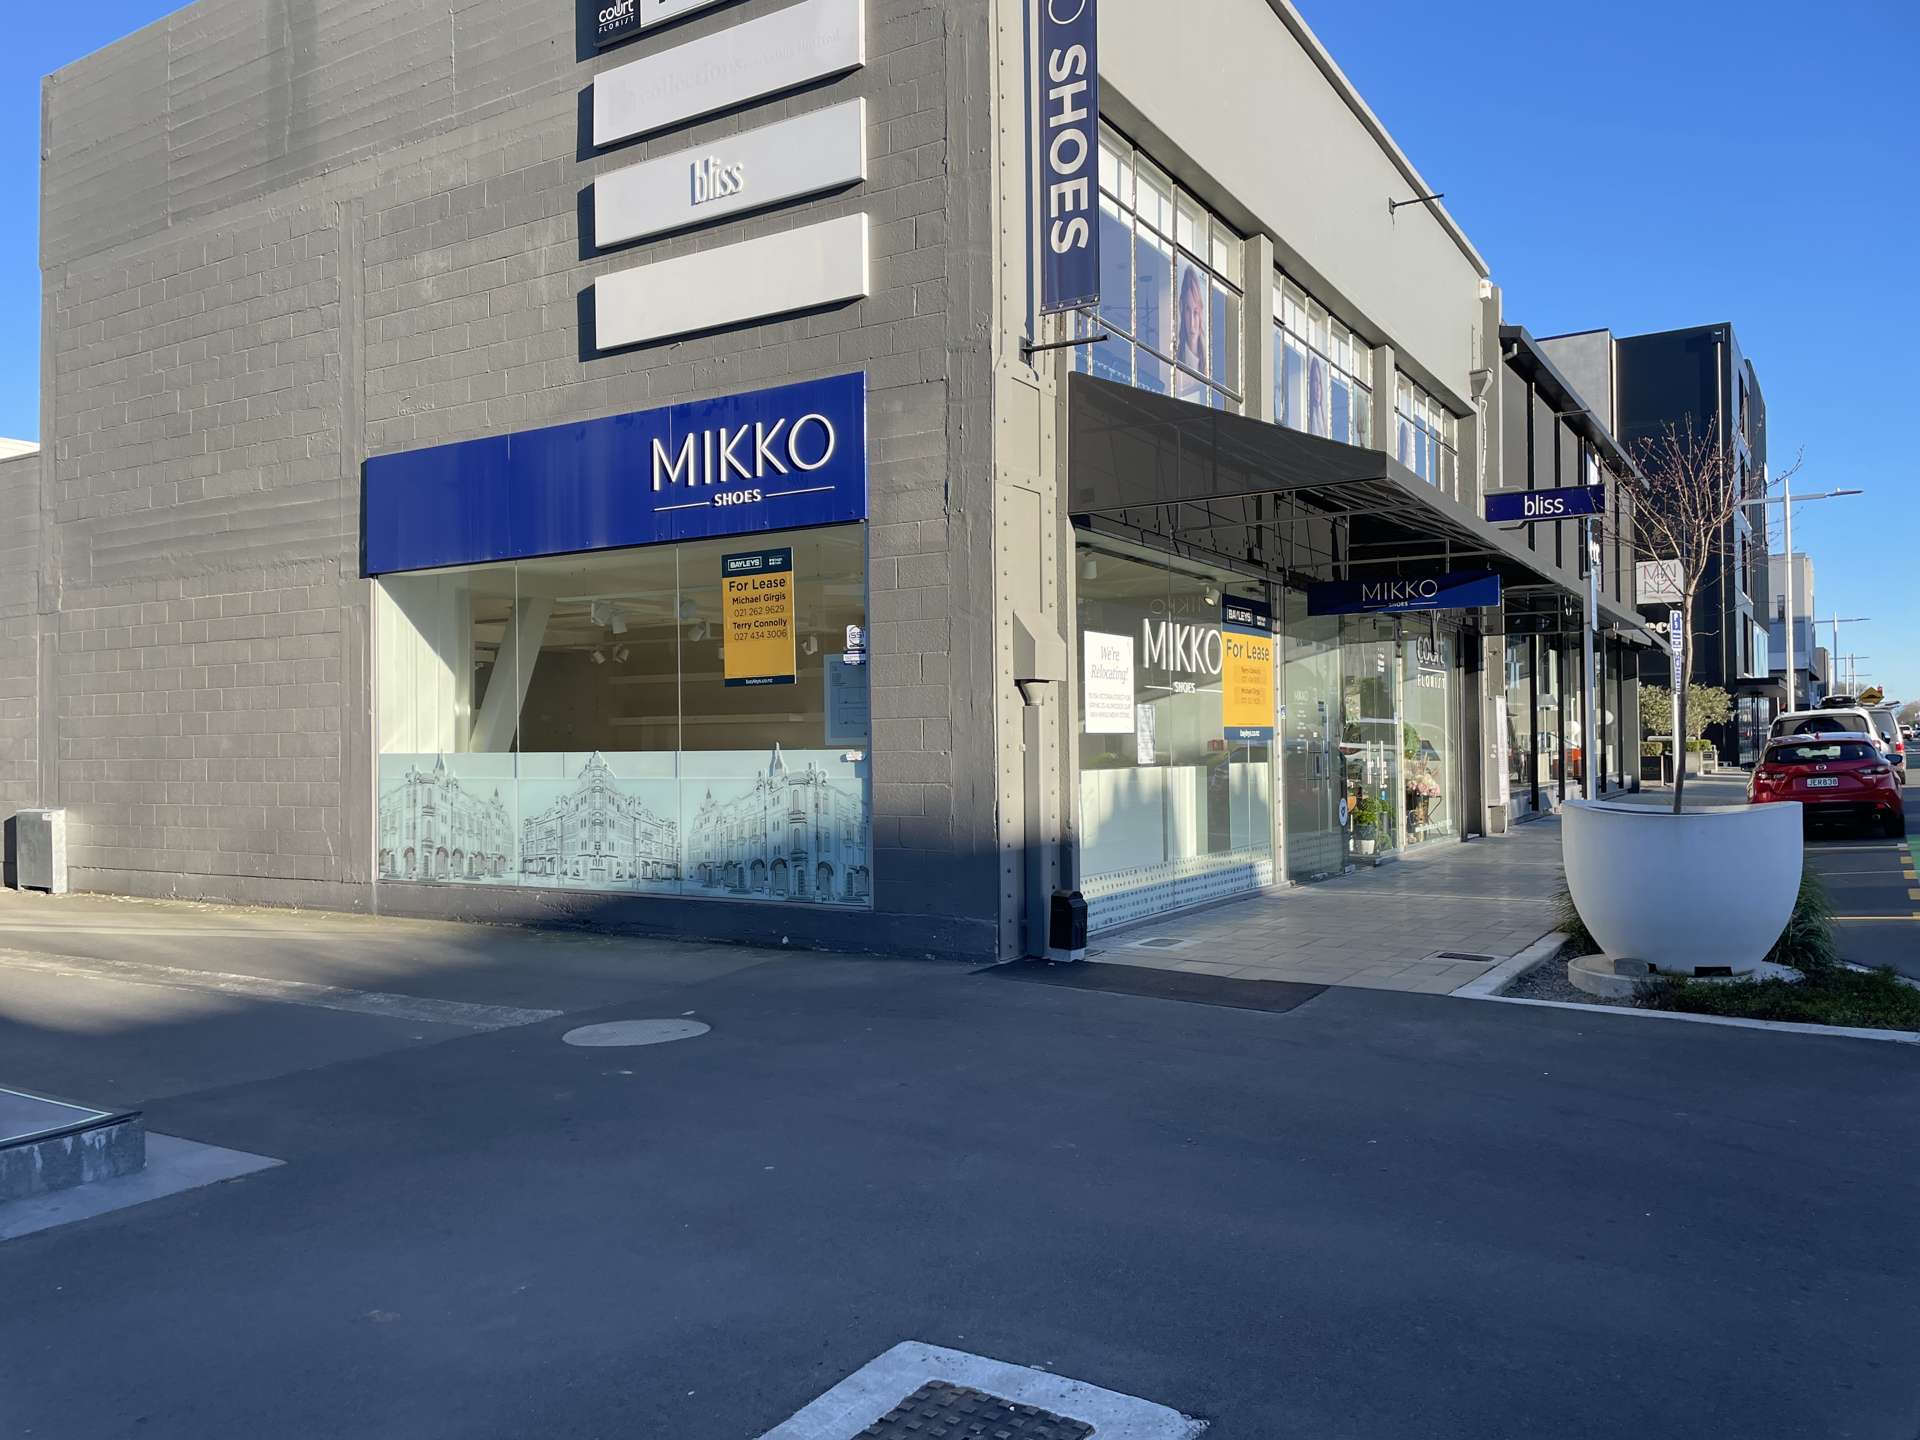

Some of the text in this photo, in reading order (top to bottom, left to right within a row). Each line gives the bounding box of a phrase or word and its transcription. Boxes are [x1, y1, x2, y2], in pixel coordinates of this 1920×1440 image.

[599, 16, 634, 33] FLORIST
[1048, 44, 1090, 254] SHOES
[690, 156, 744, 206] bliss
[652, 413, 835, 491] MIKKO
[714, 489, 762, 507] SHOES
[1524, 495, 1564, 516] bliss
[729, 559, 760, 569] BAYLEYS
[728, 578, 786, 592] For Lease
[1362, 579, 1438, 602] MIKKO
[732, 592, 786, 605] Michael Girgis
[734, 608, 747, 617] 021
[748, 606, 763, 616] 262
[1228, 608, 1252, 624] BAYLEYS
[732, 618, 788, 631] Terry Connolly
[734, 632, 748, 641] 027
[1100, 646, 1120, 662] We're
[1143, 618, 1223, 675] MIKKO
[1226, 639, 1270, 662] For Lease
[1091, 663, 1129, 684] Relocating!
[1417, 673, 1446, 689] FLORIST
[1173, 681, 1196, 694] SHOES
